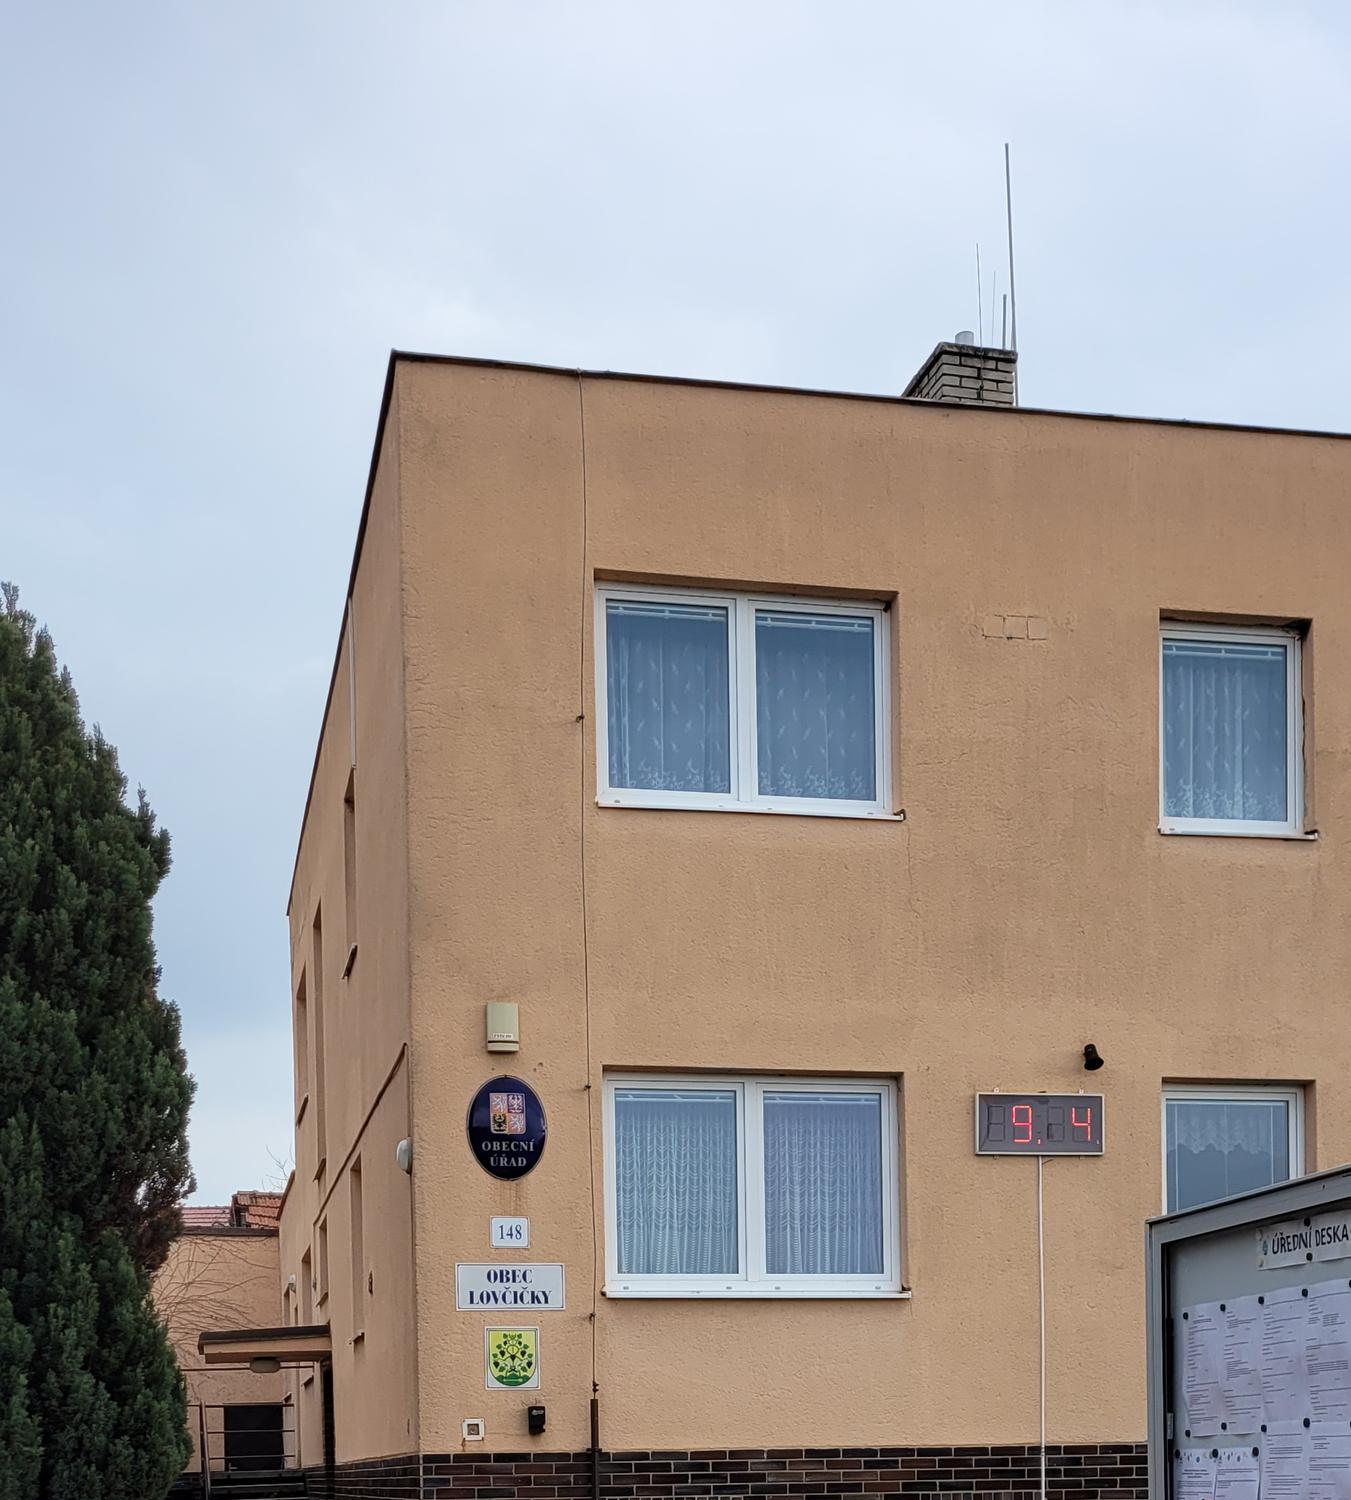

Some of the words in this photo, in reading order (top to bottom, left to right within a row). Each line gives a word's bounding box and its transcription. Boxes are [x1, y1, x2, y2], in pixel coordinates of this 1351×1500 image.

[481, 1139, 535, 1151] OBECNÍ
[490, 1153, 527, 1167] ÚŘAD
[498, 1224, 522, 1240] 148
[1271, 1226, 1312, 1255] ÚŘEDNÍ
[1315, 1223, 1349, 1247] DESKA
[486, 1269, 533, 1284] OBEC
[469, 1286, 552, 1305] LOVČIČKY
